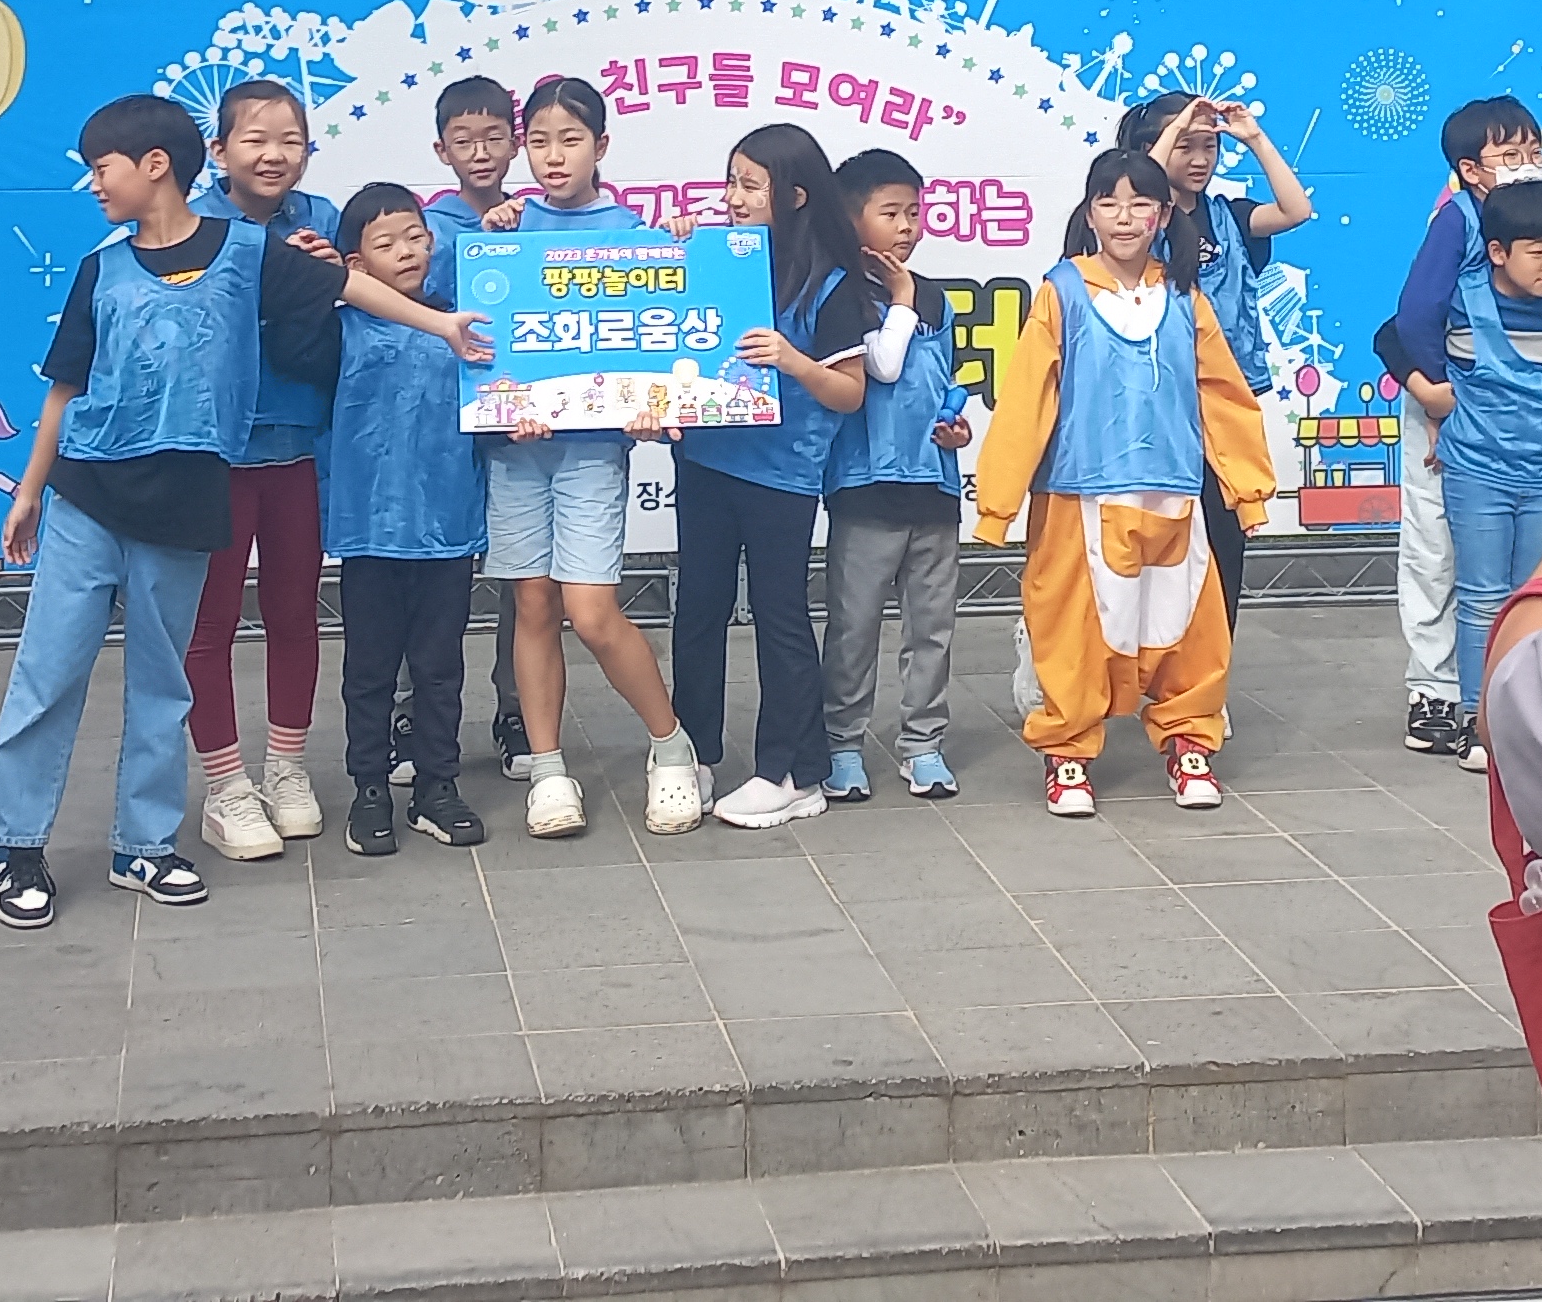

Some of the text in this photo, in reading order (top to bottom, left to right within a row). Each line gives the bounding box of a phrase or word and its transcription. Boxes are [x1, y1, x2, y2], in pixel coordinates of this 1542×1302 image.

[600, 52, 755, 116] 친구들
[544, 248, 582, 262] 2023
[542, 265, 687, 298] 팡팡놀이터
[510, 306, 723, 353] 조화로움상
